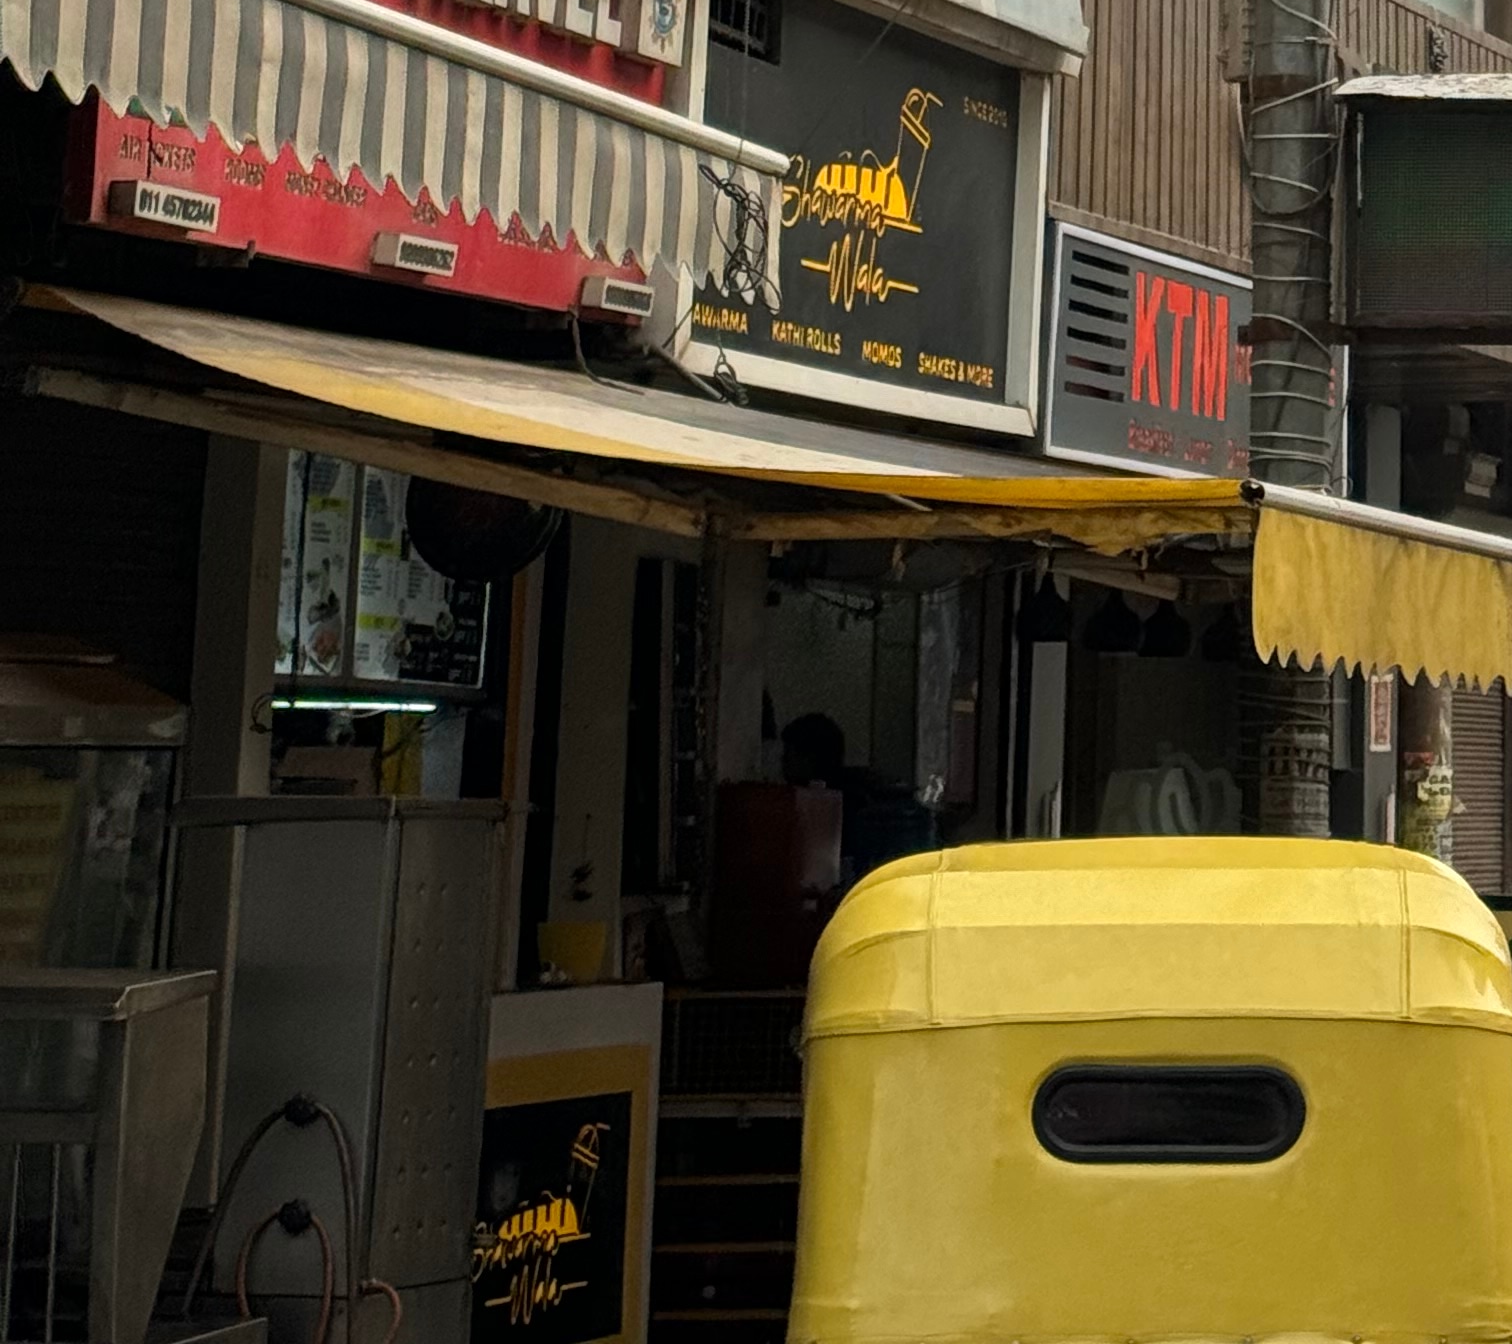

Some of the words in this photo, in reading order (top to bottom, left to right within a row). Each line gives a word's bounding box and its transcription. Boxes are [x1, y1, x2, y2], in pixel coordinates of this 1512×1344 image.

[801, 229, 919, 313] Wala
[771, 319, 804, 347] KATHI
[805, 326, 842, 356] ROLLS
[861, 340, 903, 369] MOMOS
[1131, 270, 1230, 422] KTM
[917, 351, 957, 383] SHAKES
[966, 364, 994, 390] MORE
